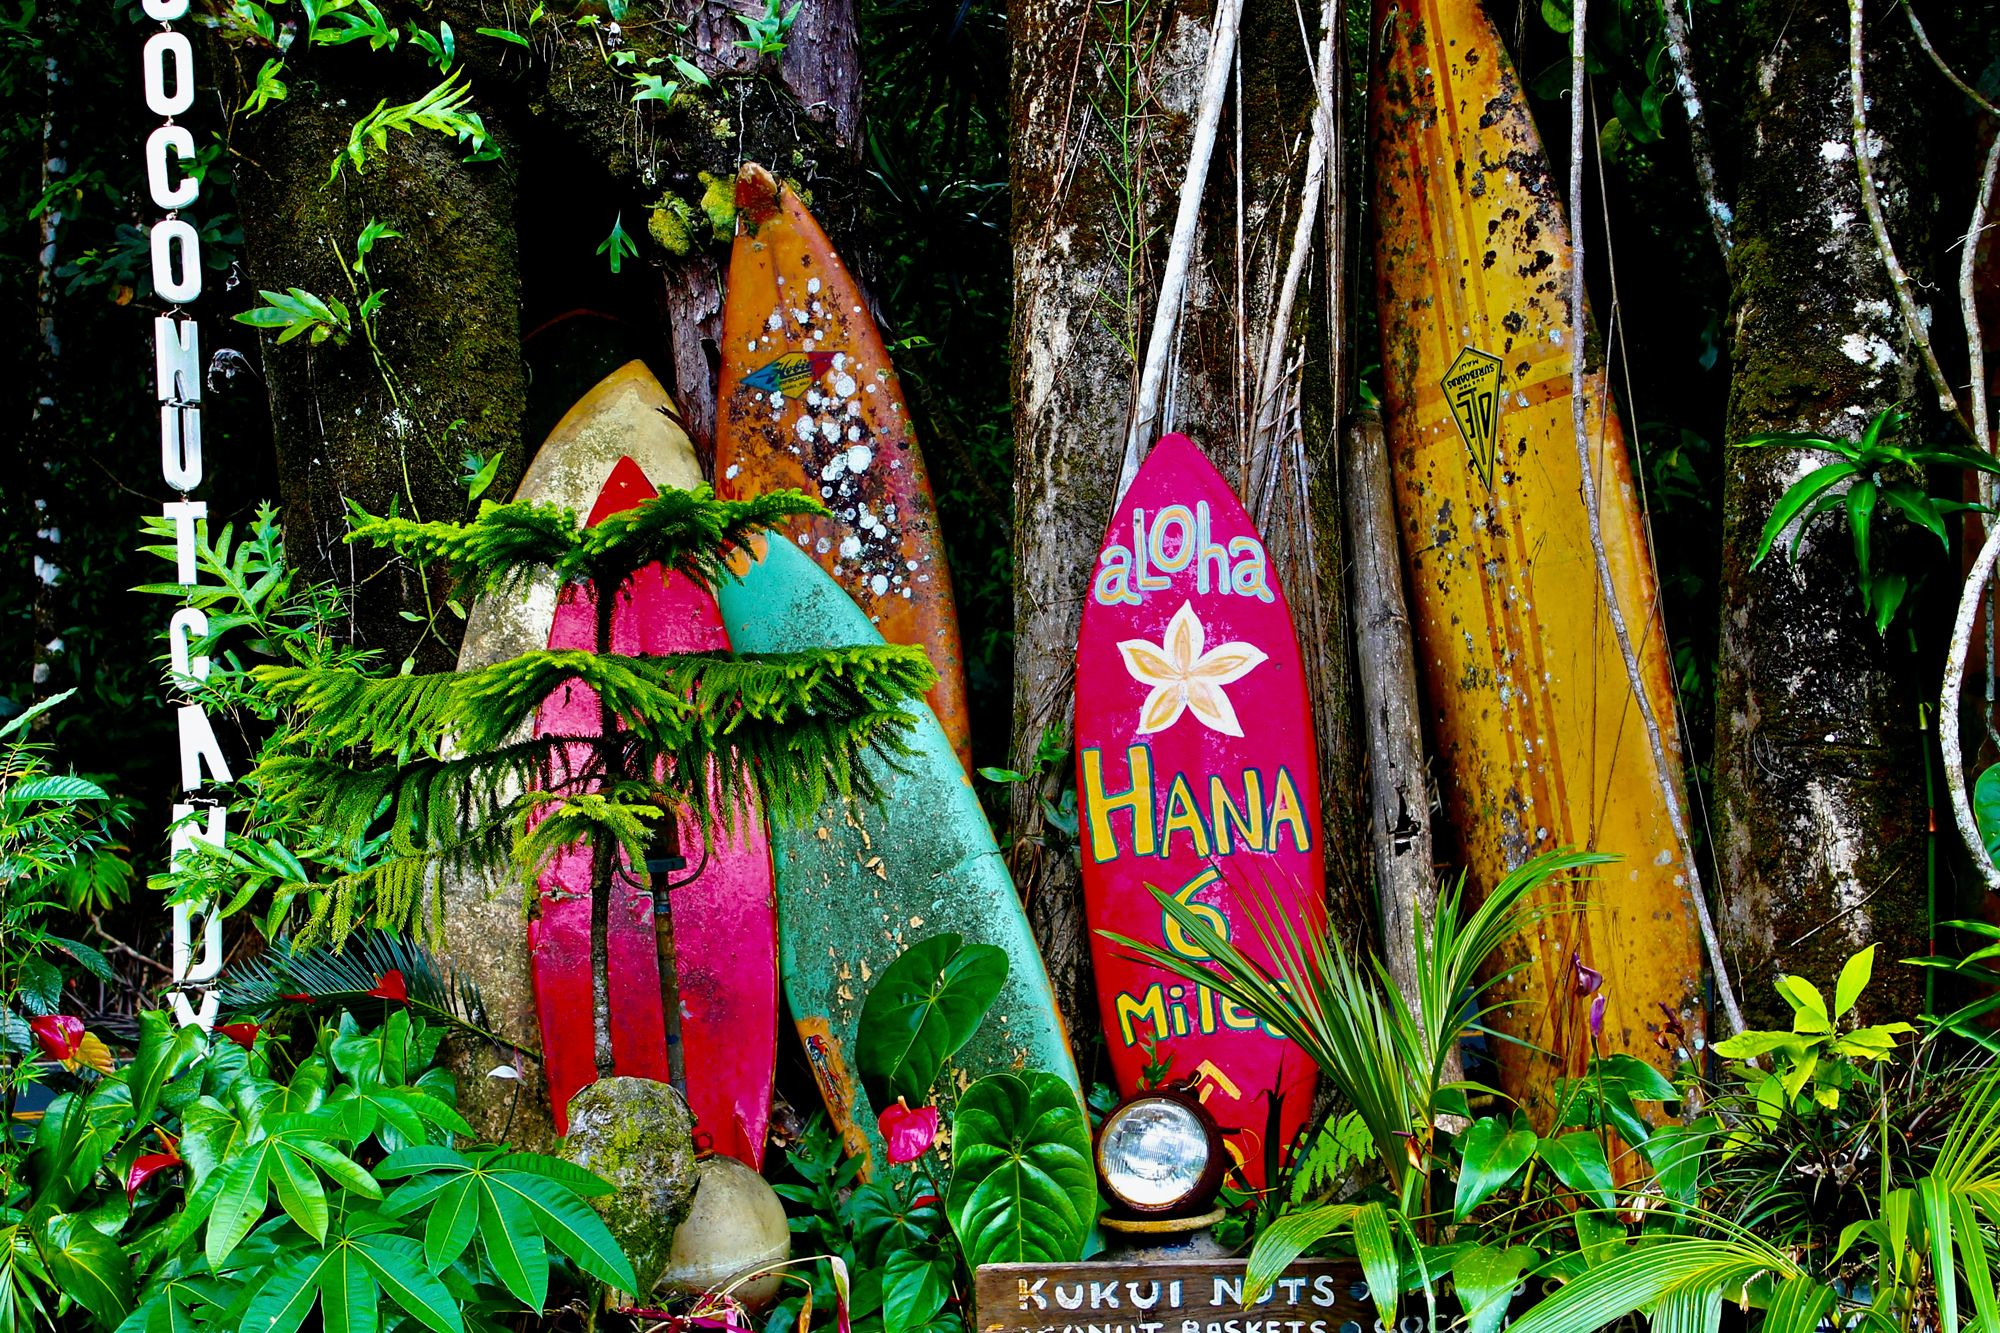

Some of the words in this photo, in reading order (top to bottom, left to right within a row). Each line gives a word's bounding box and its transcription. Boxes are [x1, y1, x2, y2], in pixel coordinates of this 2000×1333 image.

[141, 0, 207, 585] OCONUT
[1446, 362, 1495, 390] SURFBOARDS
[1458, 358, 1479, 372] MAUI
[1081, 743, 1312, 864] HANA
[1161, 865, 1232, 962] 6
[1017, 1277, 1184, 1311] KUKUI
